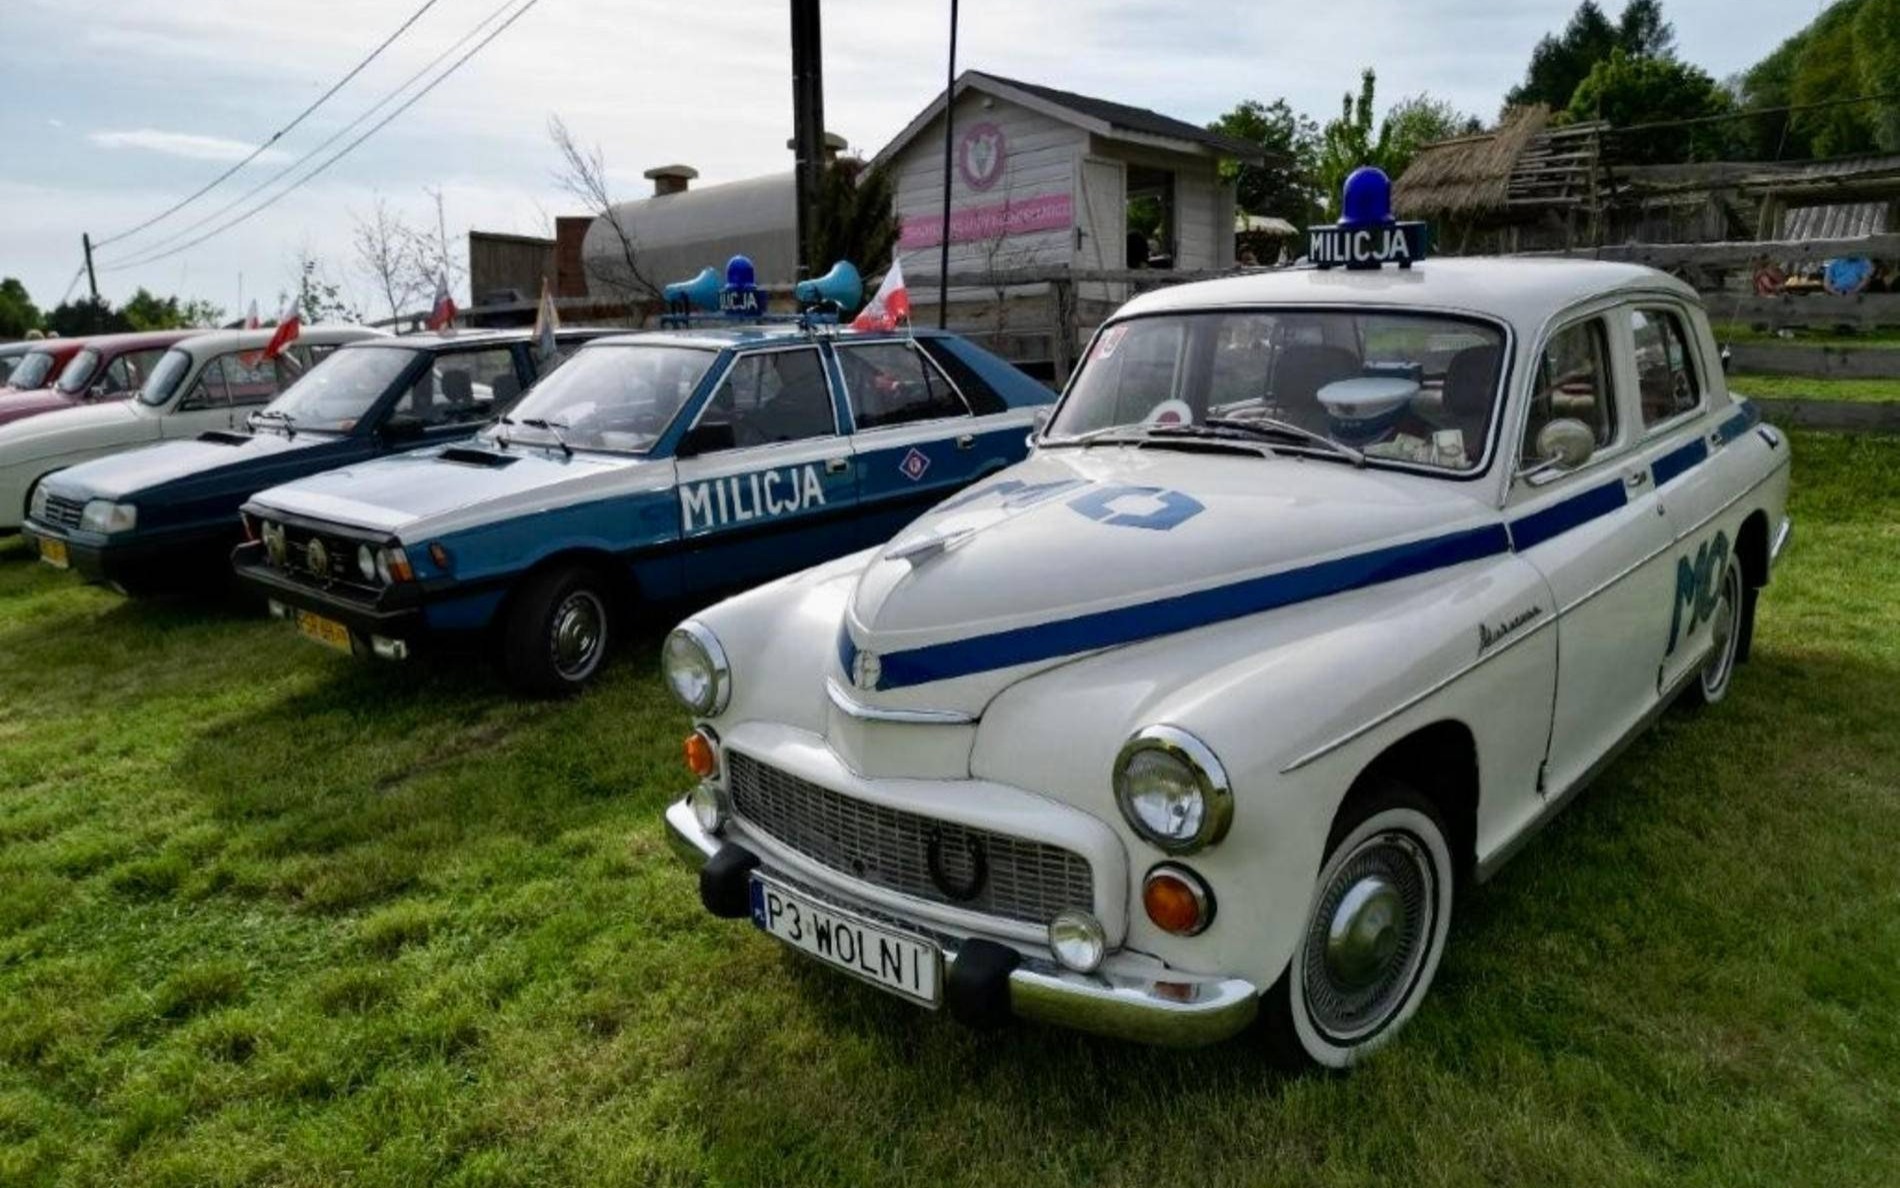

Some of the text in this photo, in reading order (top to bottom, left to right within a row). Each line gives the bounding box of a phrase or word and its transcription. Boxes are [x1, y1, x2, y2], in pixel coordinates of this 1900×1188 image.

[1310, 229, 1410, 262] MILICJA
[679, 465, 826, 531] MILICJA
[767, 892, 919, 990] P3 WOLNI
